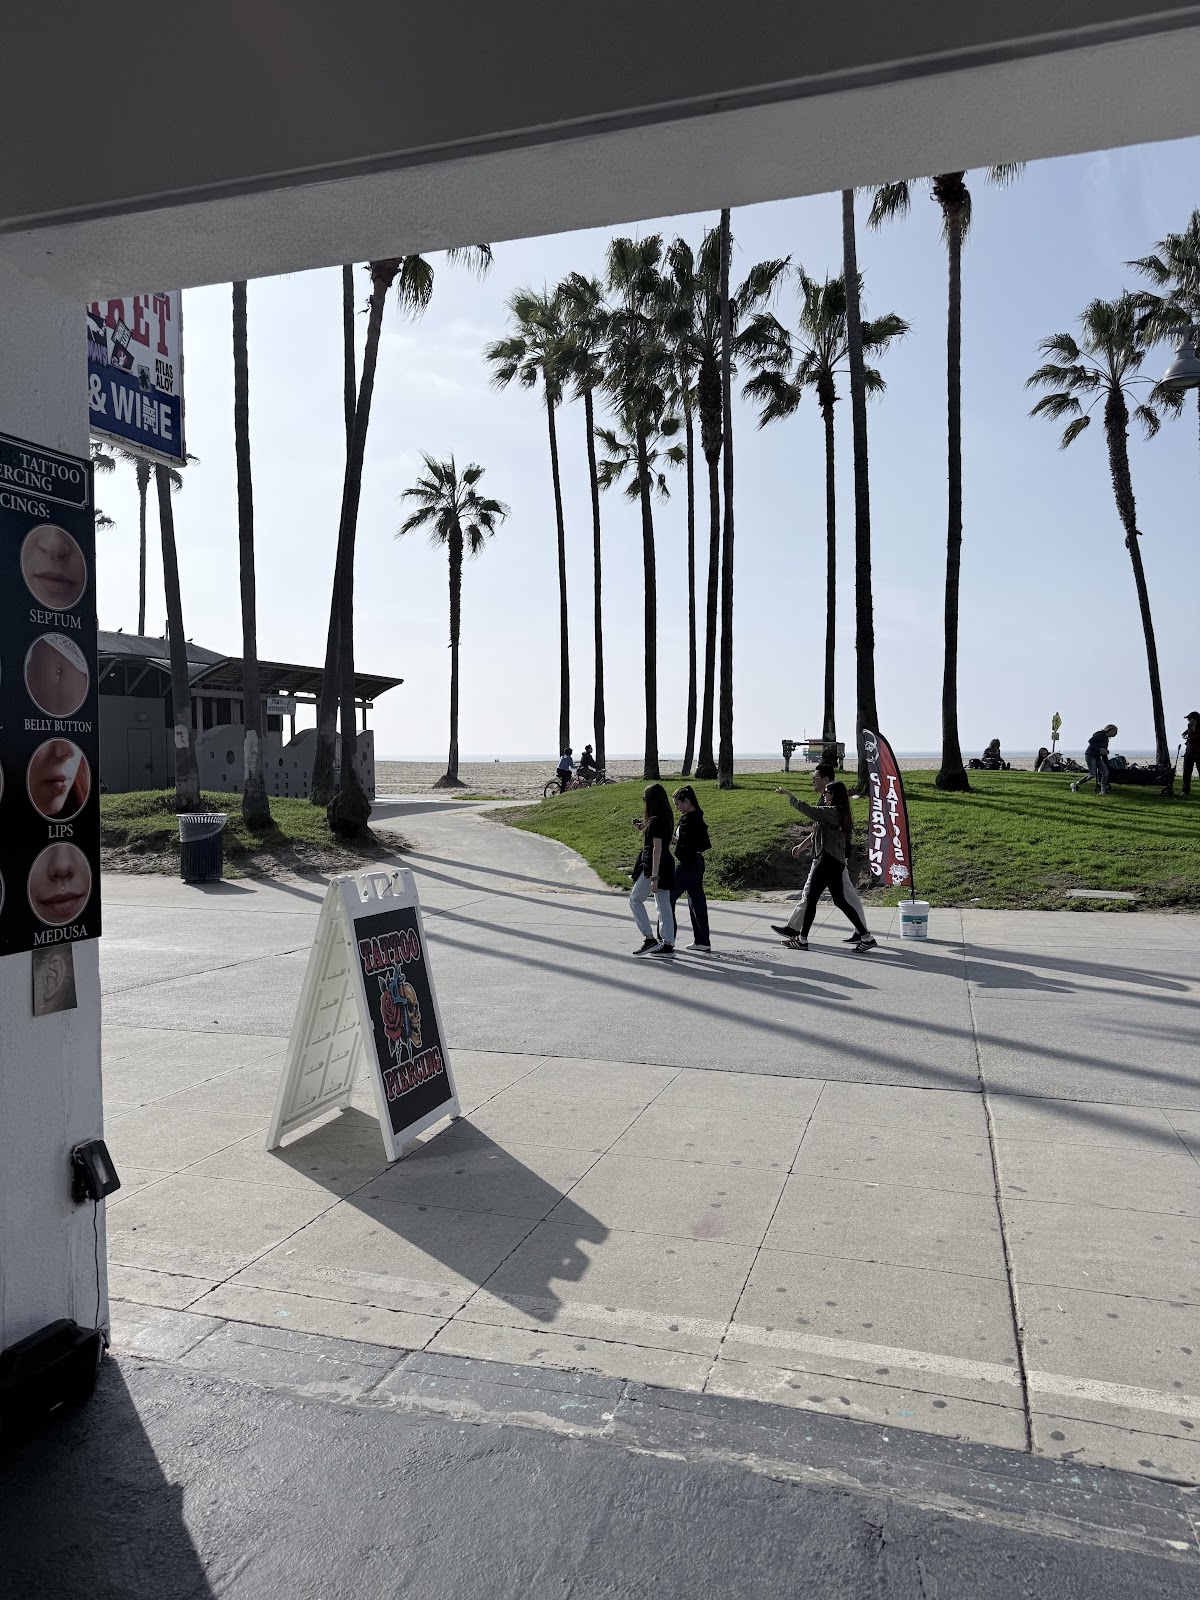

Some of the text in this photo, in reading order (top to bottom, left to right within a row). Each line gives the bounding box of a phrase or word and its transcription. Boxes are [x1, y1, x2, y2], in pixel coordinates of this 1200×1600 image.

[155, 358, 173, 380] ATLAS
[155, 373, 174, 393] ALOY
[88, 373, 107, 415] &
[111, 381, 173, 440] WINE
[20, 453, 80, 484] TATTOO
[29, 608, 82, 630] SEPTUM
[24, 718, 92, 733] BELLY BUTTON
[48, 823, 74, 839] LIPS
[33, 924, 89, 946] MEDUSA
[358, 928, 421, 976] TATTOO
[383, 1046, 444, 1102] PIERCING
